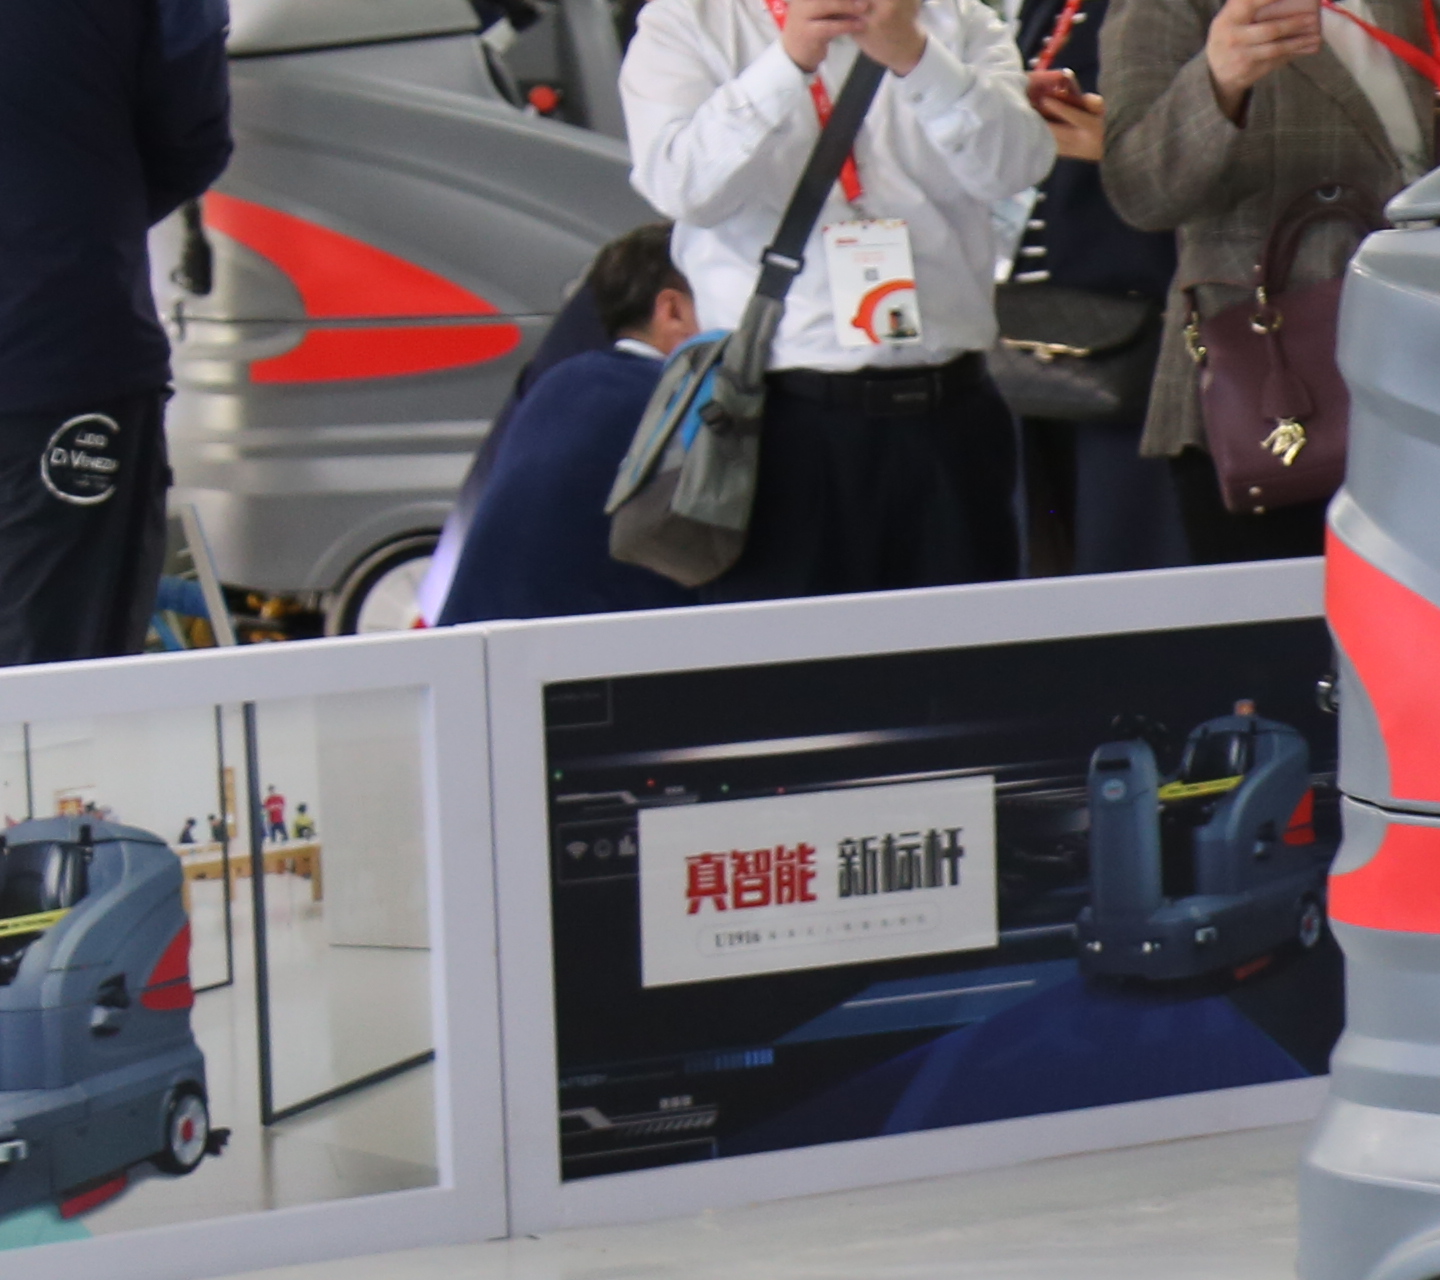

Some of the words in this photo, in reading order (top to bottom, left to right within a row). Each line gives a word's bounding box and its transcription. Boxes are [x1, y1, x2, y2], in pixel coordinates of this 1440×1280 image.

[684, 841, 819, 916] 真智能
[836, 825, 965, 899] 新标杆
